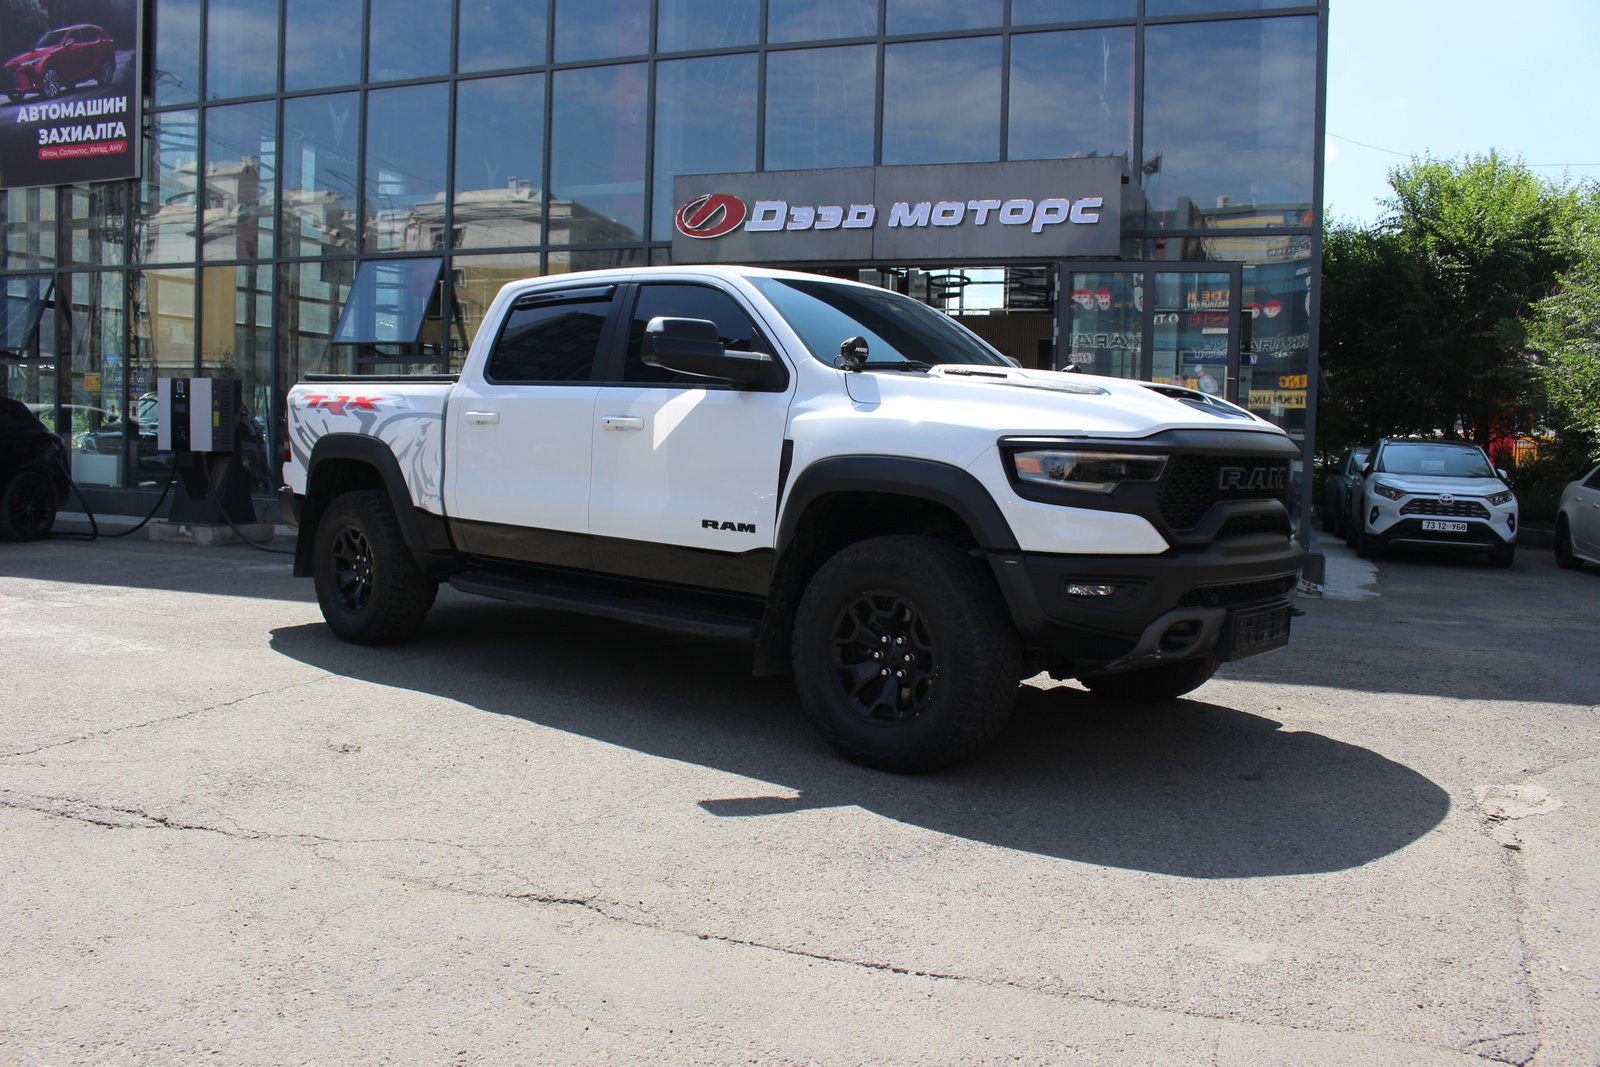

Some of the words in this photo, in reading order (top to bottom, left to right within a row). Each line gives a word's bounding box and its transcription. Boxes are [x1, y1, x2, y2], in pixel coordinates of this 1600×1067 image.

[17, 96, 127, 123] АВТОМАШИН
[38, 121, 127, 145] ЗАХИАЛГА
[304, 395, 384, 416] TRX
[1218, 466, 1287, 490] RAM
[701, 519, 756, 534] RAM
